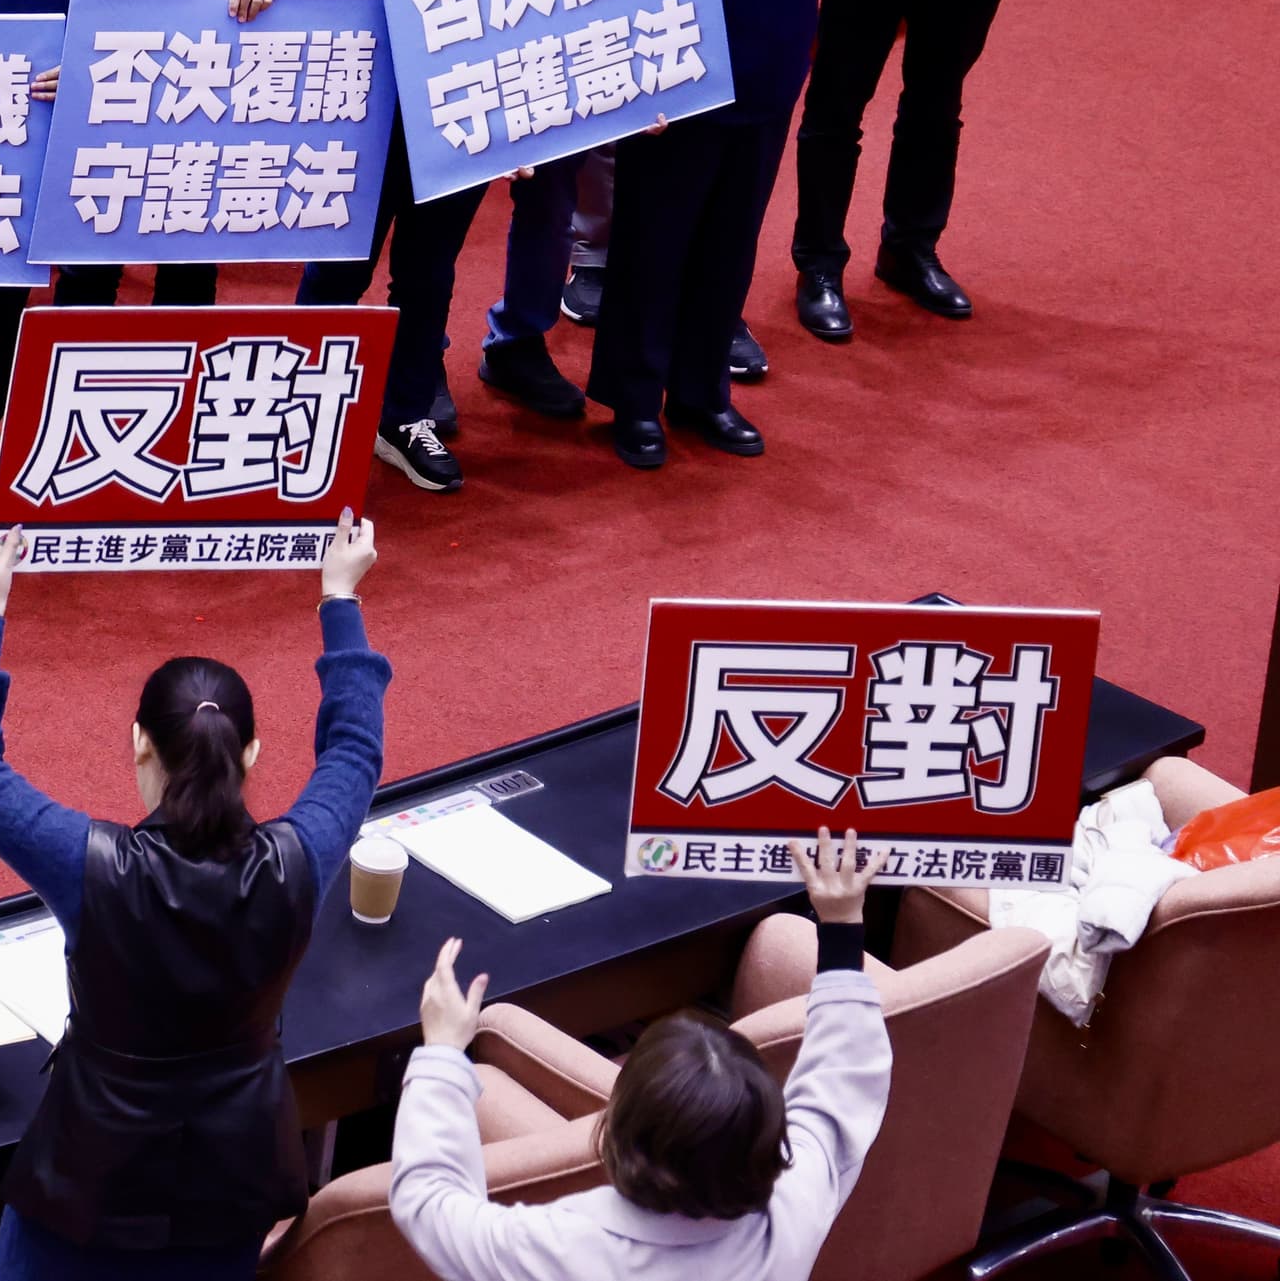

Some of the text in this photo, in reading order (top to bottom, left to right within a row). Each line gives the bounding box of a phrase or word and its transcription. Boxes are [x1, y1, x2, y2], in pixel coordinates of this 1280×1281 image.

[88, 30, 376, 124] 否決覆議
[69, 141, 358, 234] 守護憲法
[10, 336, 363, 506] 反對
[655, 641, 1060, 815] 反對
[489, 773, 533, 795] 007
